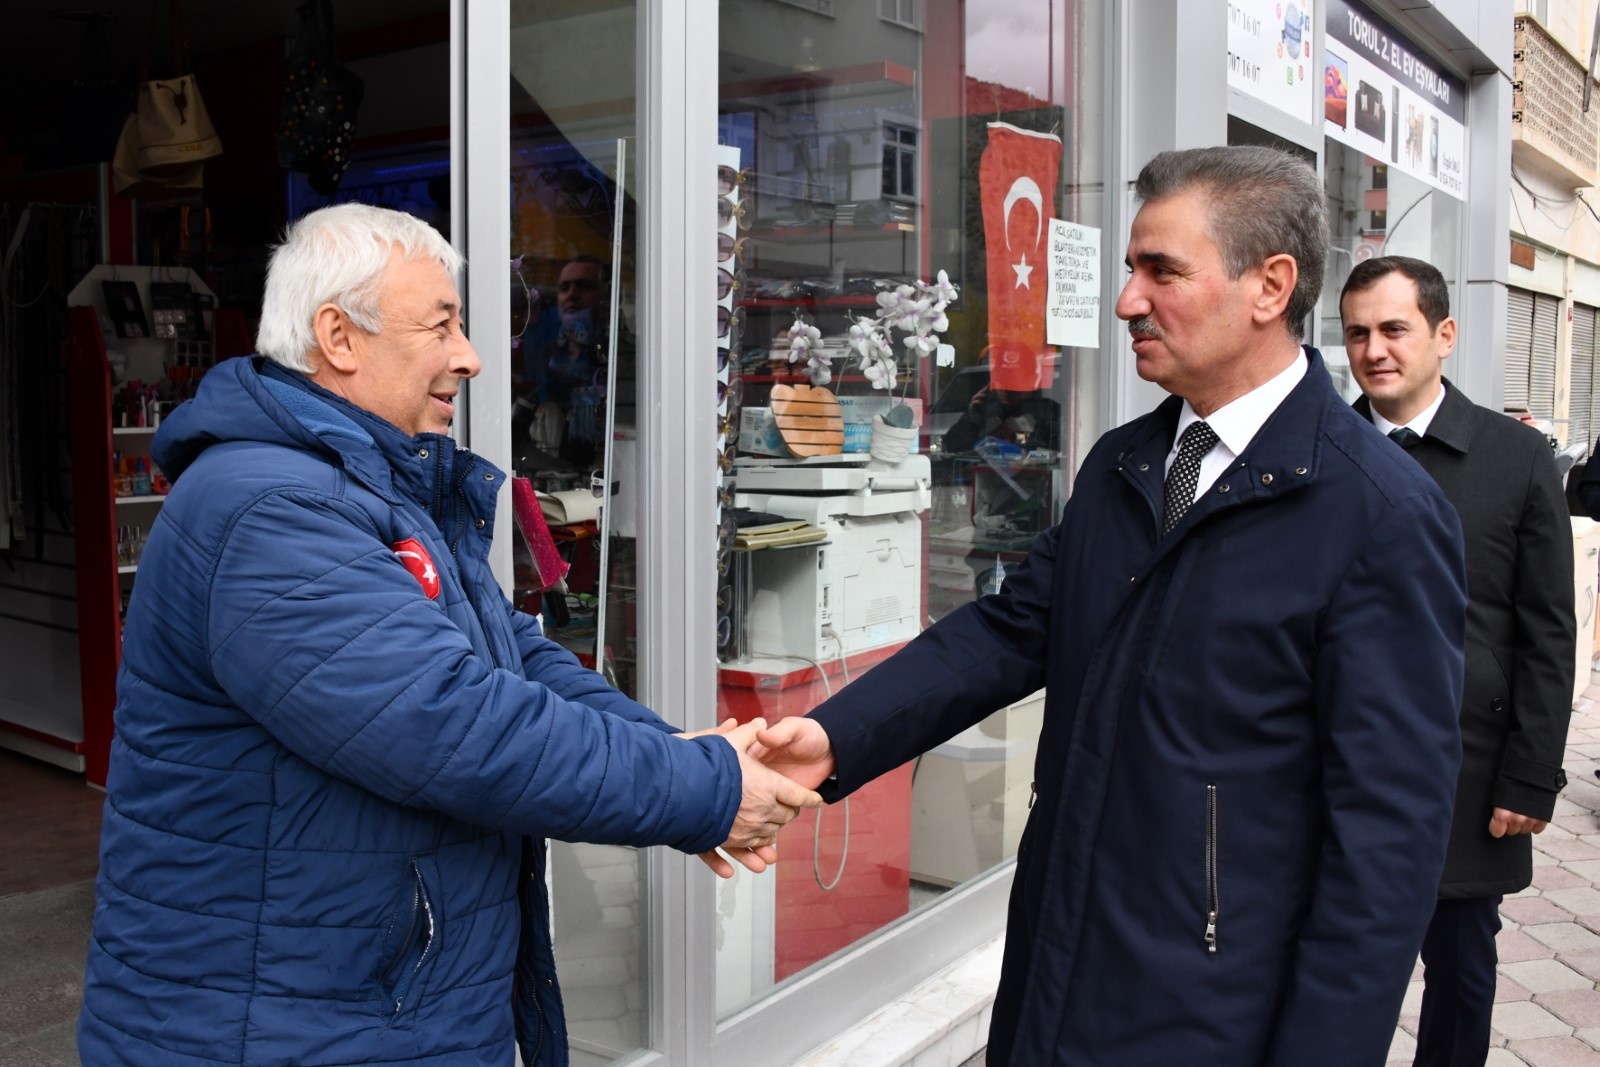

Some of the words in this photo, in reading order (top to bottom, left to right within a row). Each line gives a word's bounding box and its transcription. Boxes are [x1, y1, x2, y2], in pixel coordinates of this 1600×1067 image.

[1243, 12, 1251, 33] 16
[1252, 18, 1261, 39] 07
[1228, 51, 1240, 74] 707
[1242, 59, 1251, 80] 16
[1252, 64, 1261, 85] 07
[1347, 9, 1380, 56] TORUL
[1381, 35, 1390, 62] 2.
[1391, 42, 1402, 71] EL
[1403, 51, 1415, 79] EV
[1415, 59, 1450, 105] EŞYALARI
